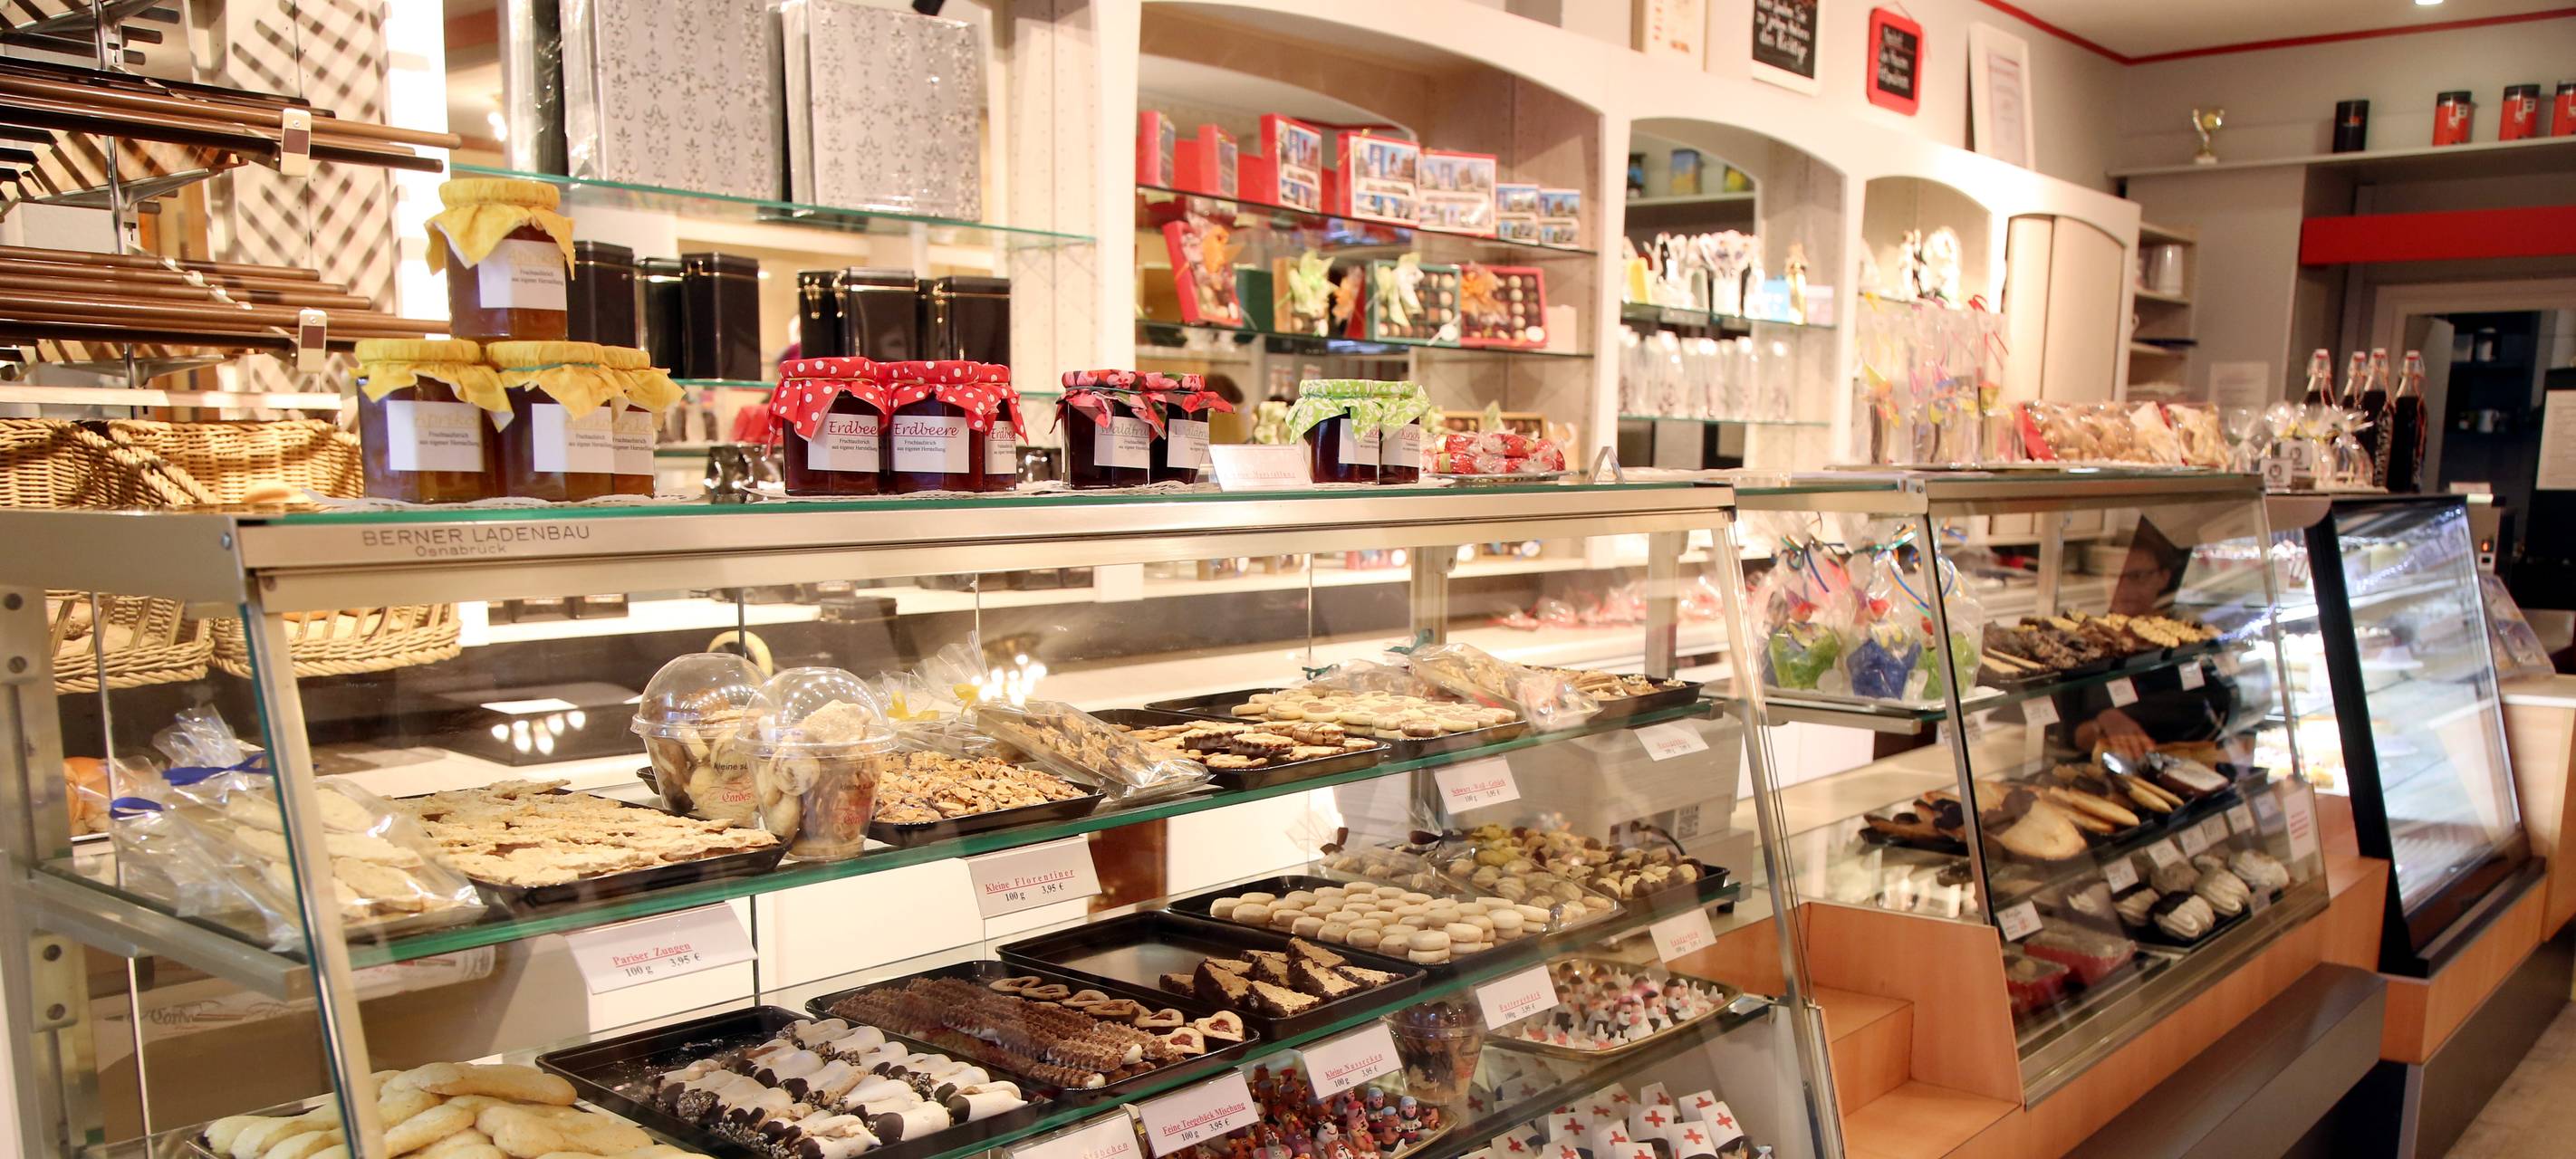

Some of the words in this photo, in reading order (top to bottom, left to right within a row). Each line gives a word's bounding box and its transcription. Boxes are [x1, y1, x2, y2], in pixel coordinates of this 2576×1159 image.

[894, 422, 959, 436] Erdbeere
[362, 528, 463, 546] BERNER
[473, 525, 590, 543] LADENBAU
[415, 544, 507, 557] Osnabrück
[985, 881, 1010, 893] Kleine
[1014, 869, 1074, 886] Florentiner
[1004, 891, 1019, 902] 100
[1020, 892, 1025, 900] g
[1042, 883, 1057, 895] 3,95
[1059, 882, 1064, 891] €
[612, 951, 649, 966] Pariser
[653, 942, 692, 957] Zungen
[625, 965, 643, 978] 100
[645, 965, 653, 974] g
[670, 954, 691, 968] 3,95
[694, 952, 702, 962] €
[1324, 1068, 1342, 1079] Kleine
[1333, 1078, 1345, 1087] 100
[1345, 1077, 1350, 1085] g
[1162, 1124, 1180, 1135] Feine
[1215, 1102, 1245, 1117] Mischung
[1181, 1130, 1193, 1142] 100
[1195, 1130, 1200, 1138] g
[1209, 1120, 1224, 1132] 3,95
[1225, 1117, 1230, 1126] €
